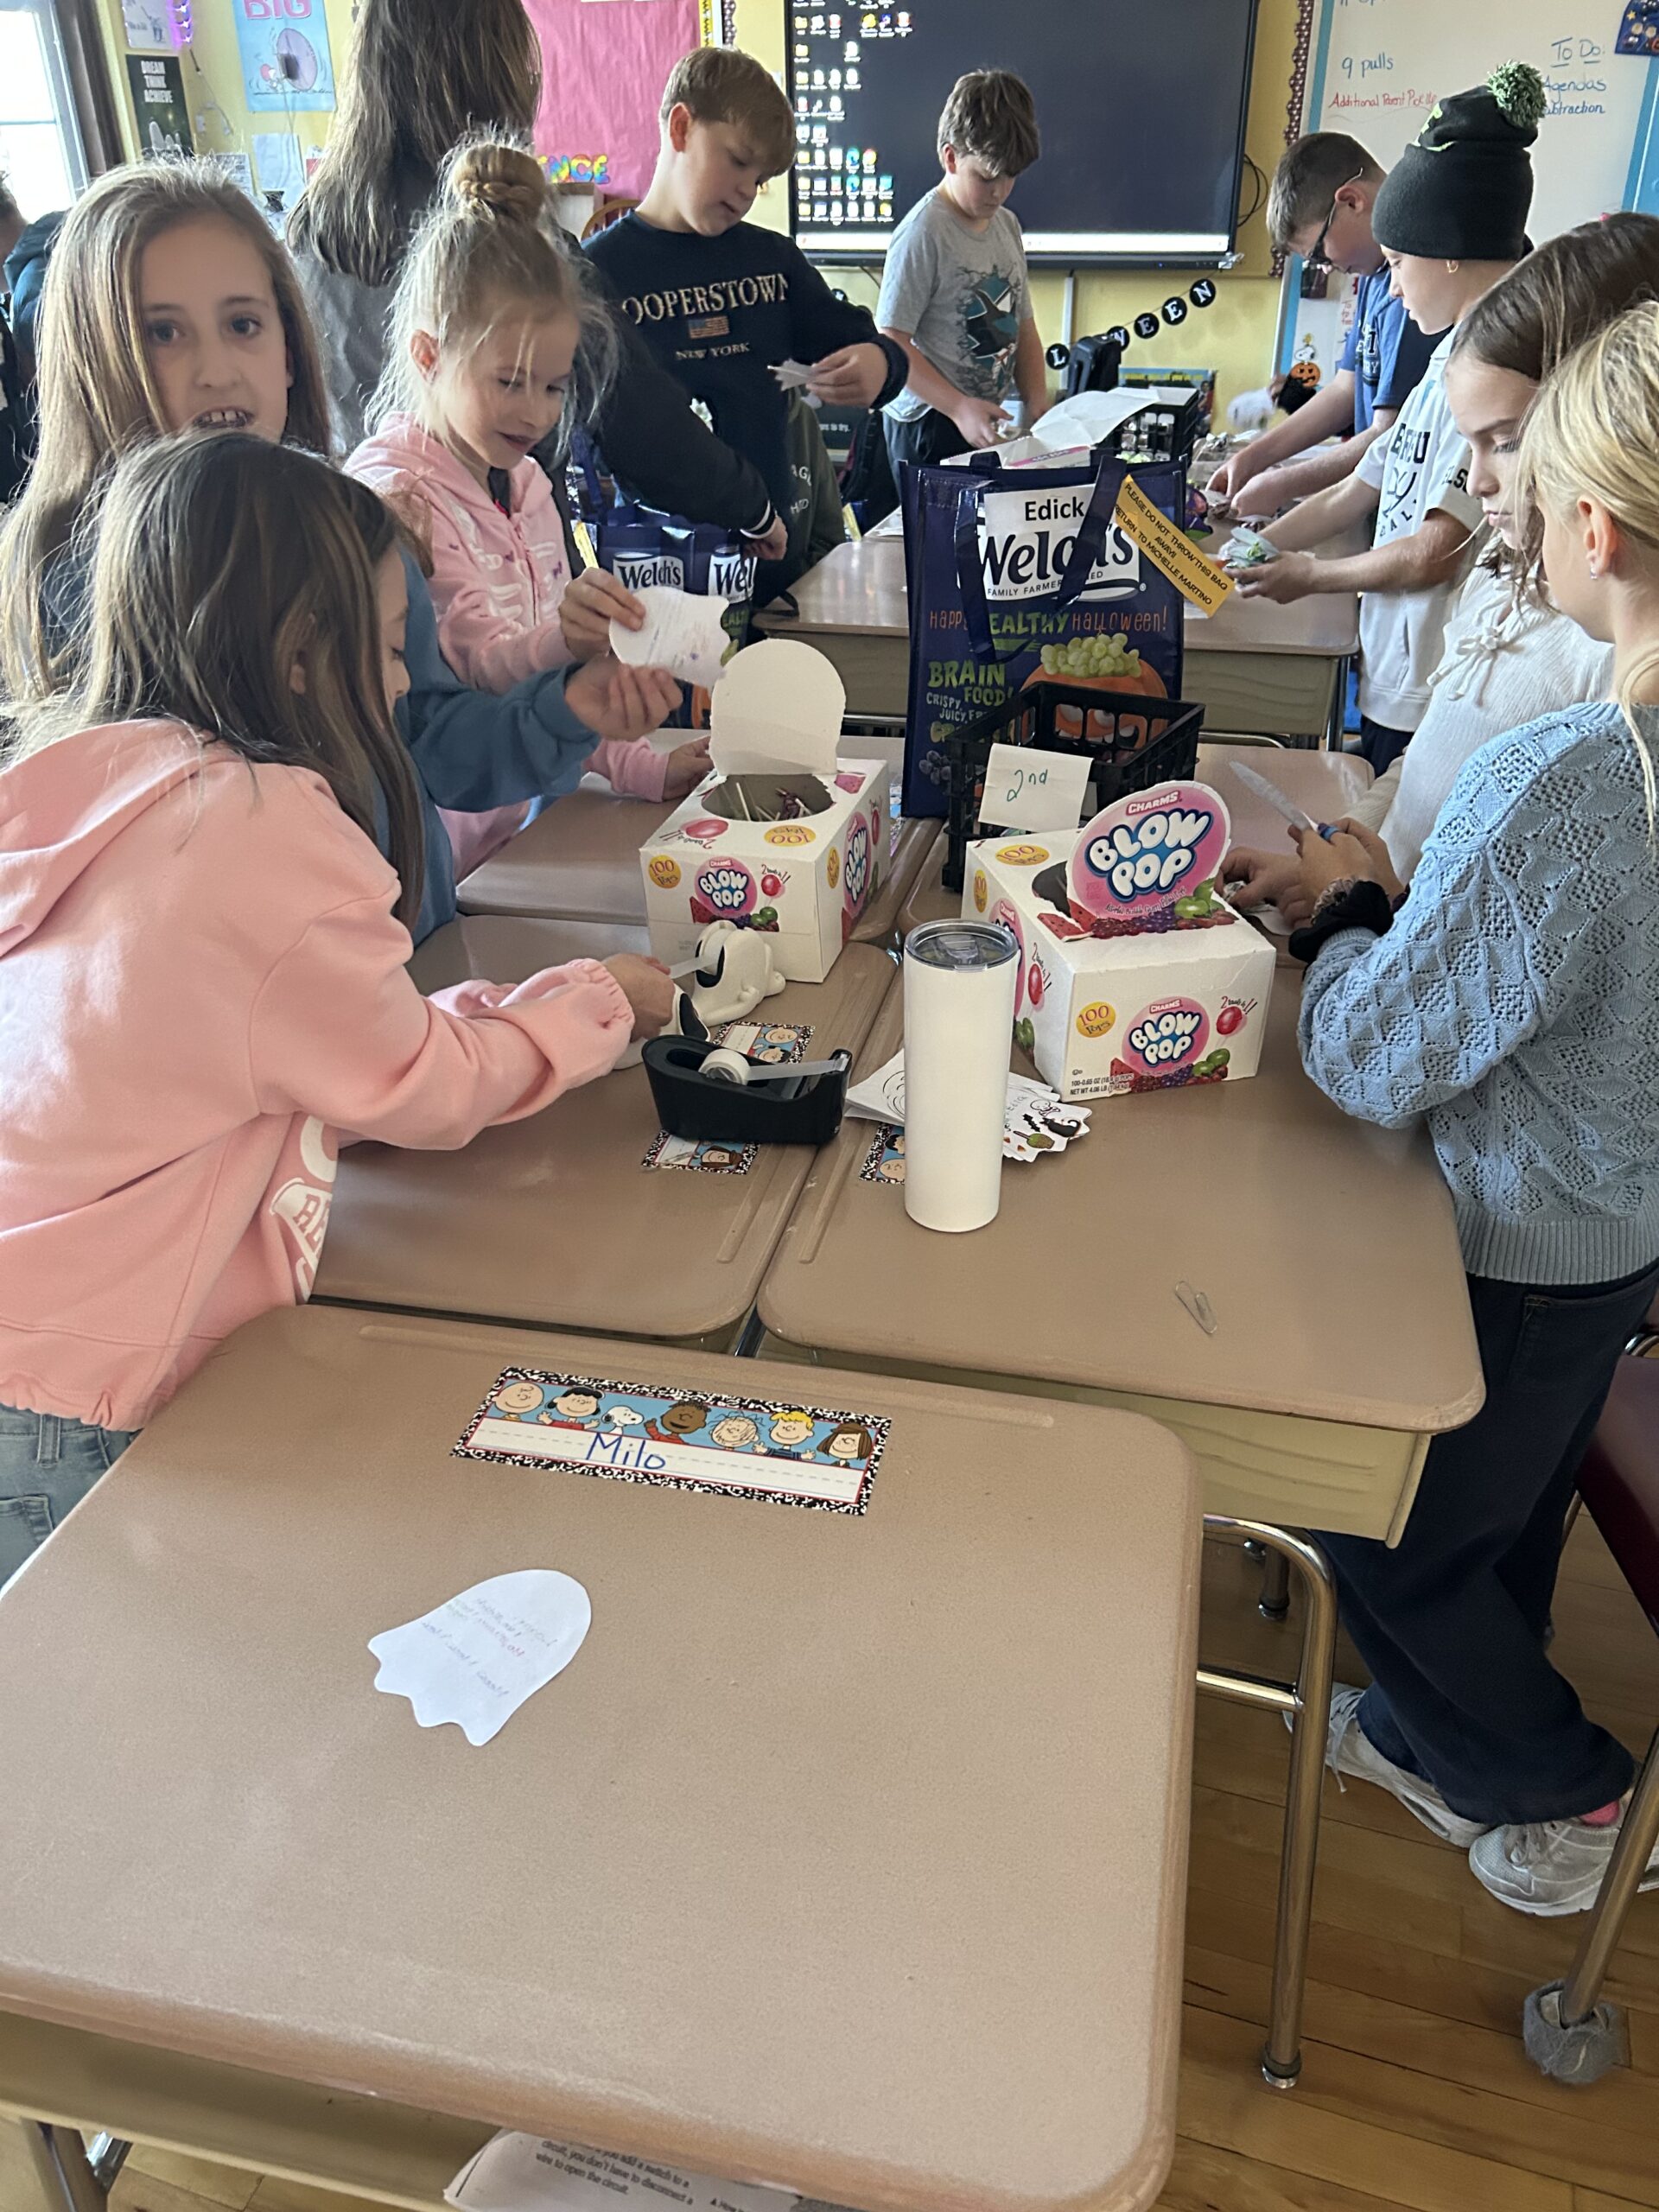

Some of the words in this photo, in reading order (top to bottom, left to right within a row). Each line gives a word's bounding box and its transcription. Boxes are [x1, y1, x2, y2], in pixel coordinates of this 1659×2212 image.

[1551, 37, 1573, 61] To
[1341, 56, 1354, 79] 9
[1361, 52, 1395, 78] pulls
[1328, 92, 1379, 109] Additional
[1542, 74, 1607, 105] Agendas
[1543, 100, 1605, 115] ubtraction
[538, 154, 610, 184] NCE
[621, 273, 789, 325] OOPERSTOWN
[676, 349, 707, 360] NEW
[710, 342, 750, 358] YORK
[1025, 497, 1085, 521] Edick
[1124, 483, 1147, 512] PLEASE
[1145, 509, 1156, 524] DO
[1155, 520, 1171, 537] NOT
[1171, 535, 1197, 561] THROW
[1193, 557, 1211, 576] THIS
[1137, 531, 1147, 544] TO
[1146, 541, 1180, 577] MICHELLE
[1178, 574, 1213, 606] MARTINO
[988, 588, 1018, 597] FAMILY
[989, 611, 1069, 635] EALTHY
[928, 660, 1006, 688] BRAIN
[963, 686, 1014, 706] FOOD!
[1007, 769, 1048, 802] 2nd
[1128, 791, 1179, 814] CHARMS
[997, 846, 1035, 861] 100
[1089, 810, 1210, 872] BLOW
[650, 860, 675, 876] 100
[1111, 849, 1192, 897] POP
[700, 869, 747, 895] BLOW
[711, 890, 746, 908] POP
[1150, 1000, 1181, 1013] CHARMS
[1221, 995, 1228, 1009] 2
[1078, 1005, 1110, 1027] 100
[1085, 1020, 1111, 1035] Pops
[1130, 1013, 1200, 1050] BLOW
[1144, 1035, 1192, 1065] POP
[585, 1432, 666, 1471] Milo
[536, 2152, 553, 2165] wire
[554, 2158, 564, 2170] to
[563, 2164, 587, 2178] open
[587, 2171, 602, 2183] the
[569, 2150, 586, 2163] you
[586, 2155, 610, 2171] don't
[609, 2162, 630, 2179] have
[630, 2172, 640, 2183] to
[641, 2177, 687, 2202] disconnect
[686, 2197, 694, 2206] a
[620, 2155, 638, 2167] add
[644, 2164, 672, 2181] switch
[672, 2174, 683, 2185] to
